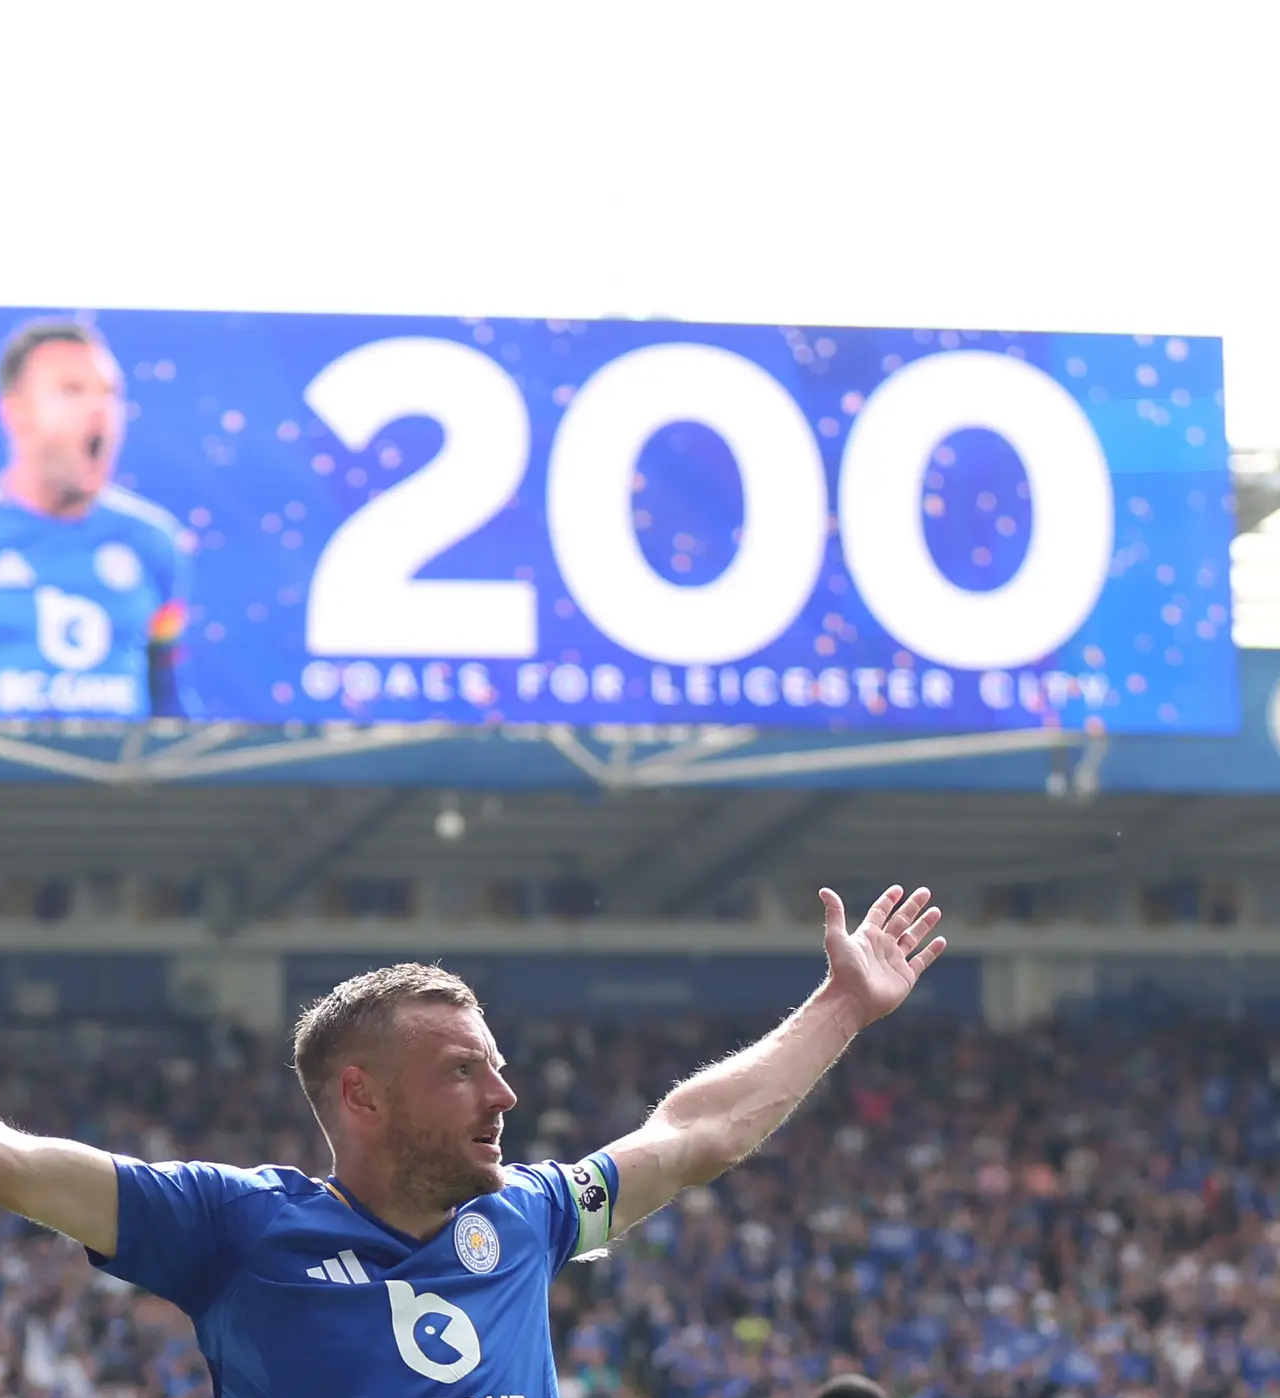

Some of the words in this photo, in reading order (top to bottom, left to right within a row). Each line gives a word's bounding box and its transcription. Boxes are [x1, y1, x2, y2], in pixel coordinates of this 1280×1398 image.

[303, 335, 1115, 671] 200
[300, 660, 494, 704] GOALS
[517, 662, 626, 705] FOR
[651, 664, 955, 709] LEICESTER
